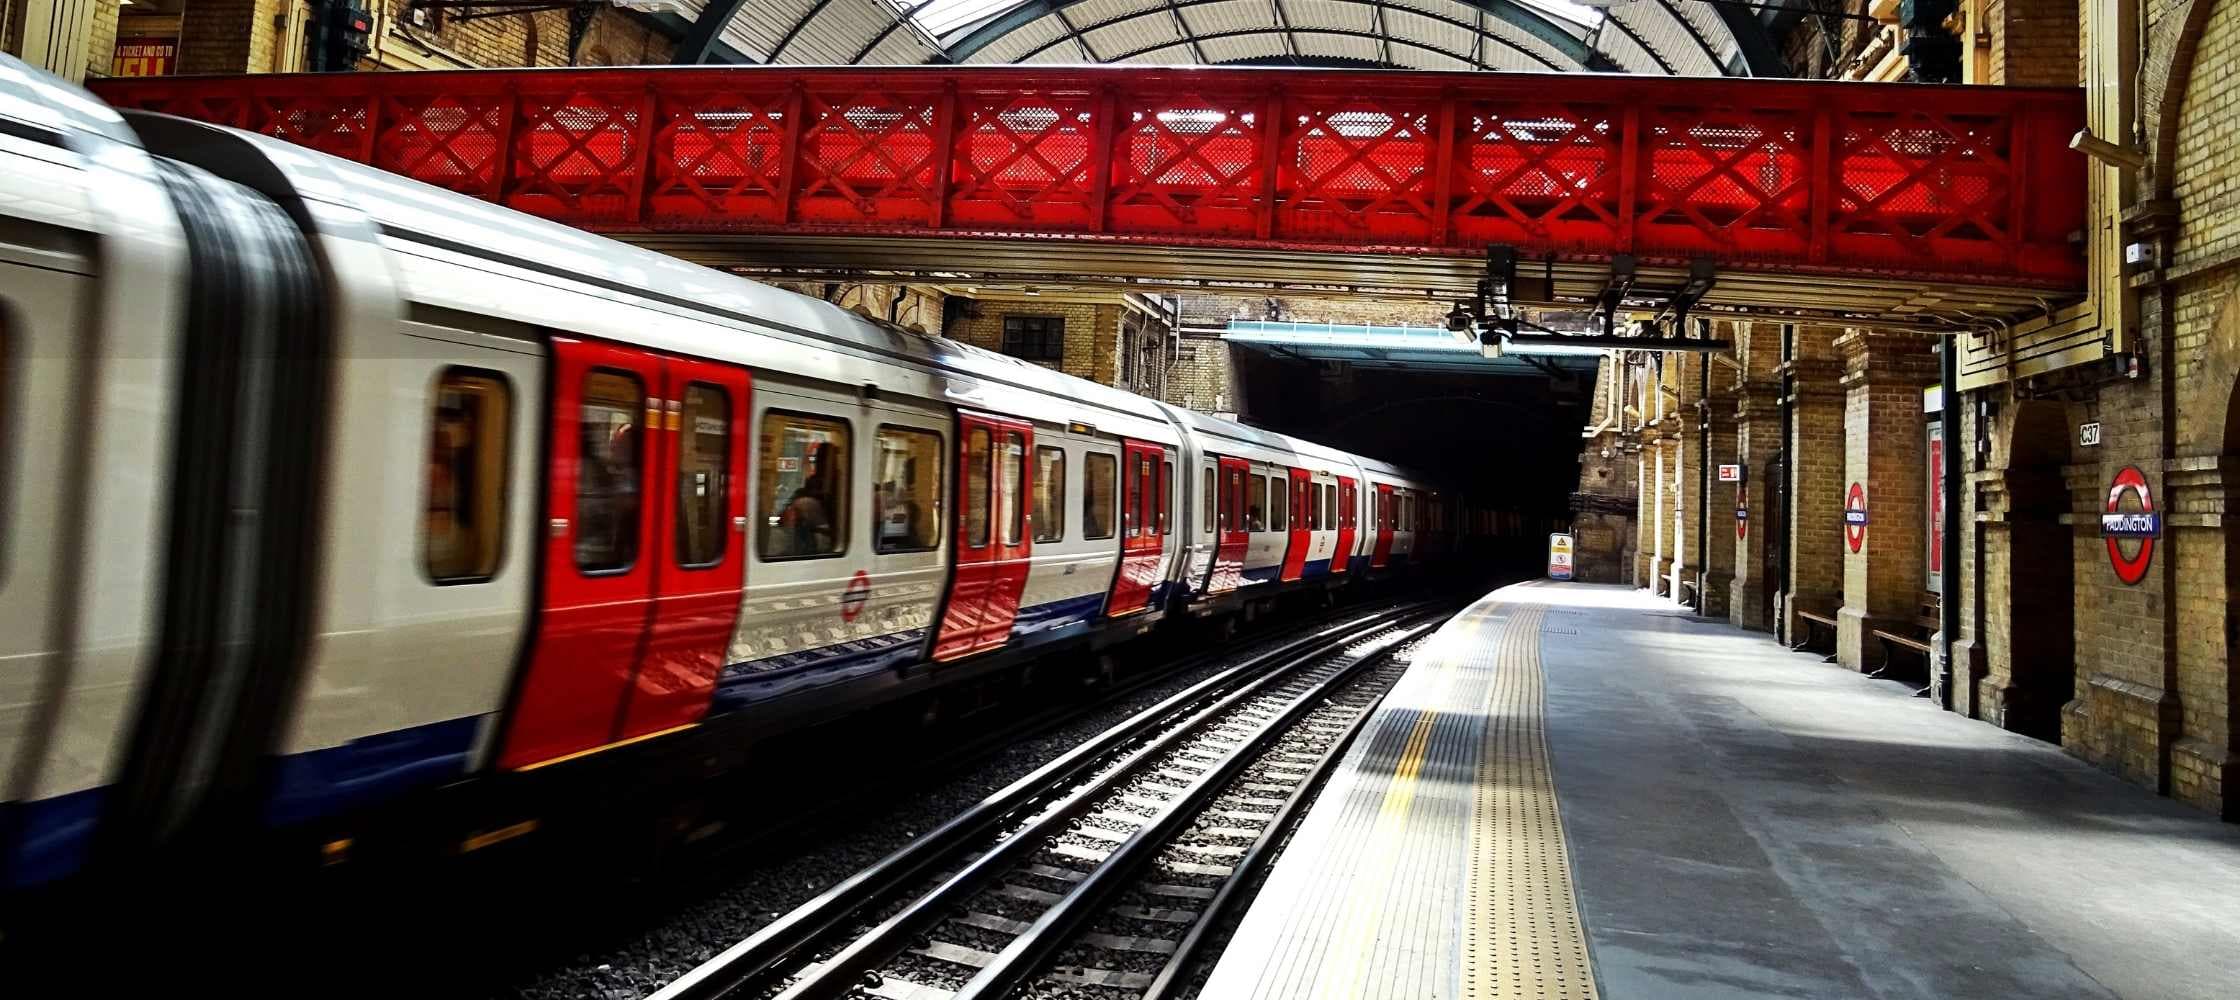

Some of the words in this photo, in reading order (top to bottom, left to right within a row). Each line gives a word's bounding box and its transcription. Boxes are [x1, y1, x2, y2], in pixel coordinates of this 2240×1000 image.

[122, 45, 143, 57] TICKET
[142, 45, 156, 57] AND
[165, 45, 173, 57] TO
[2081, 425, 2098, 443] C37
[2106, 517, 2153, 532] PADDINGTON
